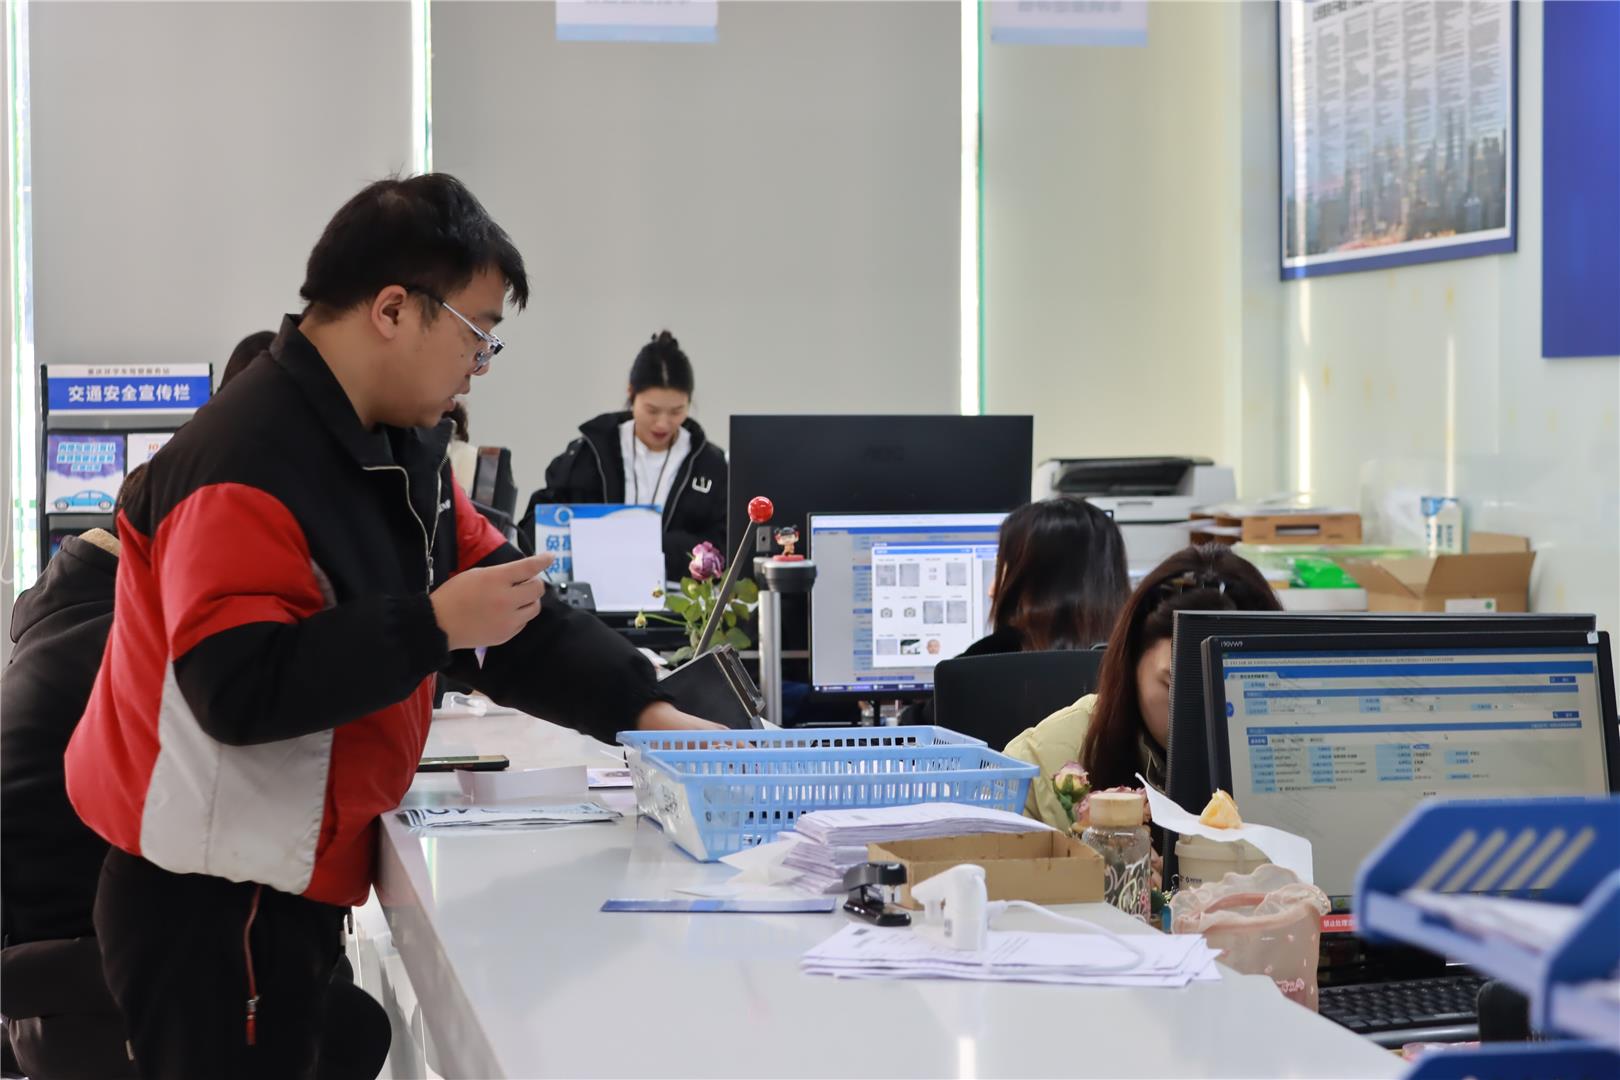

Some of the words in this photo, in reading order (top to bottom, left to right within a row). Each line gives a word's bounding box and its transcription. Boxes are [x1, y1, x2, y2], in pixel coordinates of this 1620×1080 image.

[68, 384, 190, 402] 交通安全宣传栏
